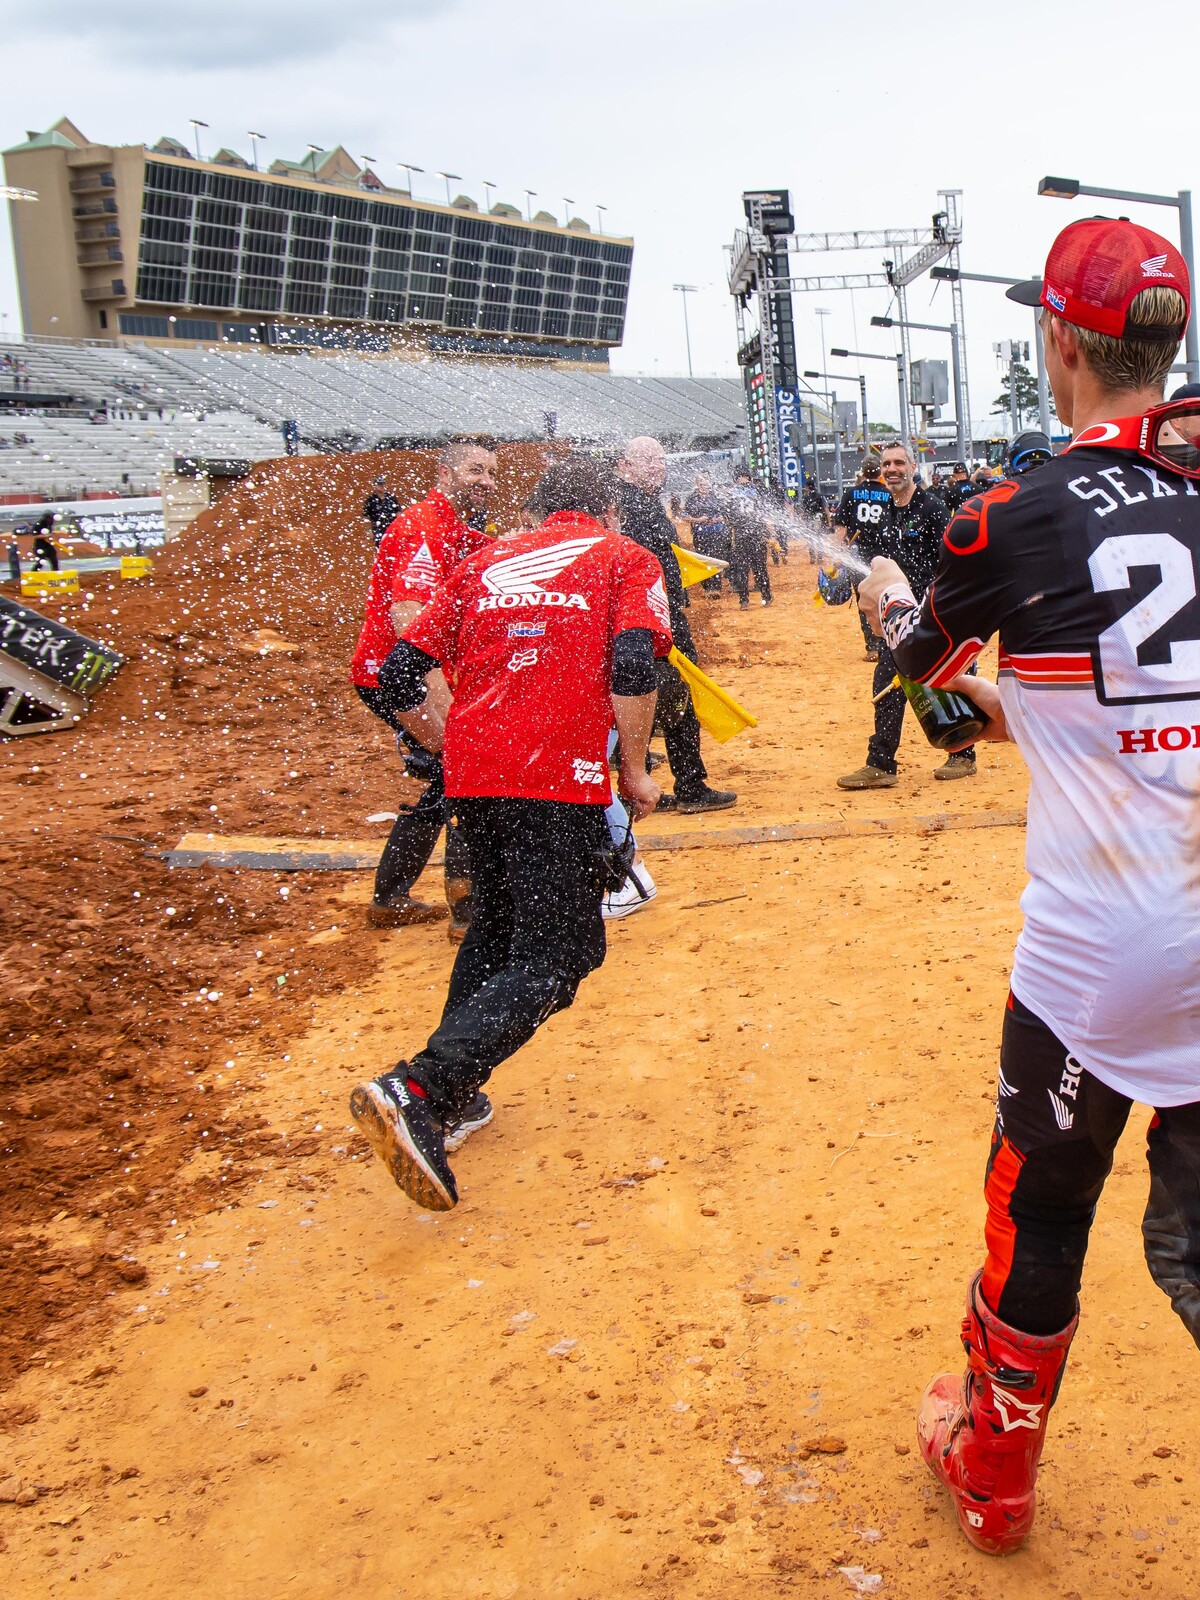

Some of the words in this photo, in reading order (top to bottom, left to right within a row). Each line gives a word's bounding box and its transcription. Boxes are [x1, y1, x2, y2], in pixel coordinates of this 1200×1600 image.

[1139, 417, 1149, 450] OAKLEY
[853, 489, 869, 500] FLAG
[870, 490, 890, 502] CREW
[857, 503, 883, 523] 09
[477, 592, 591, 613] HONDA
[507, 621, 547, 637] HRC
[571, 757, 604, 771] RIDE
[573, 769, 605, 785] RED
